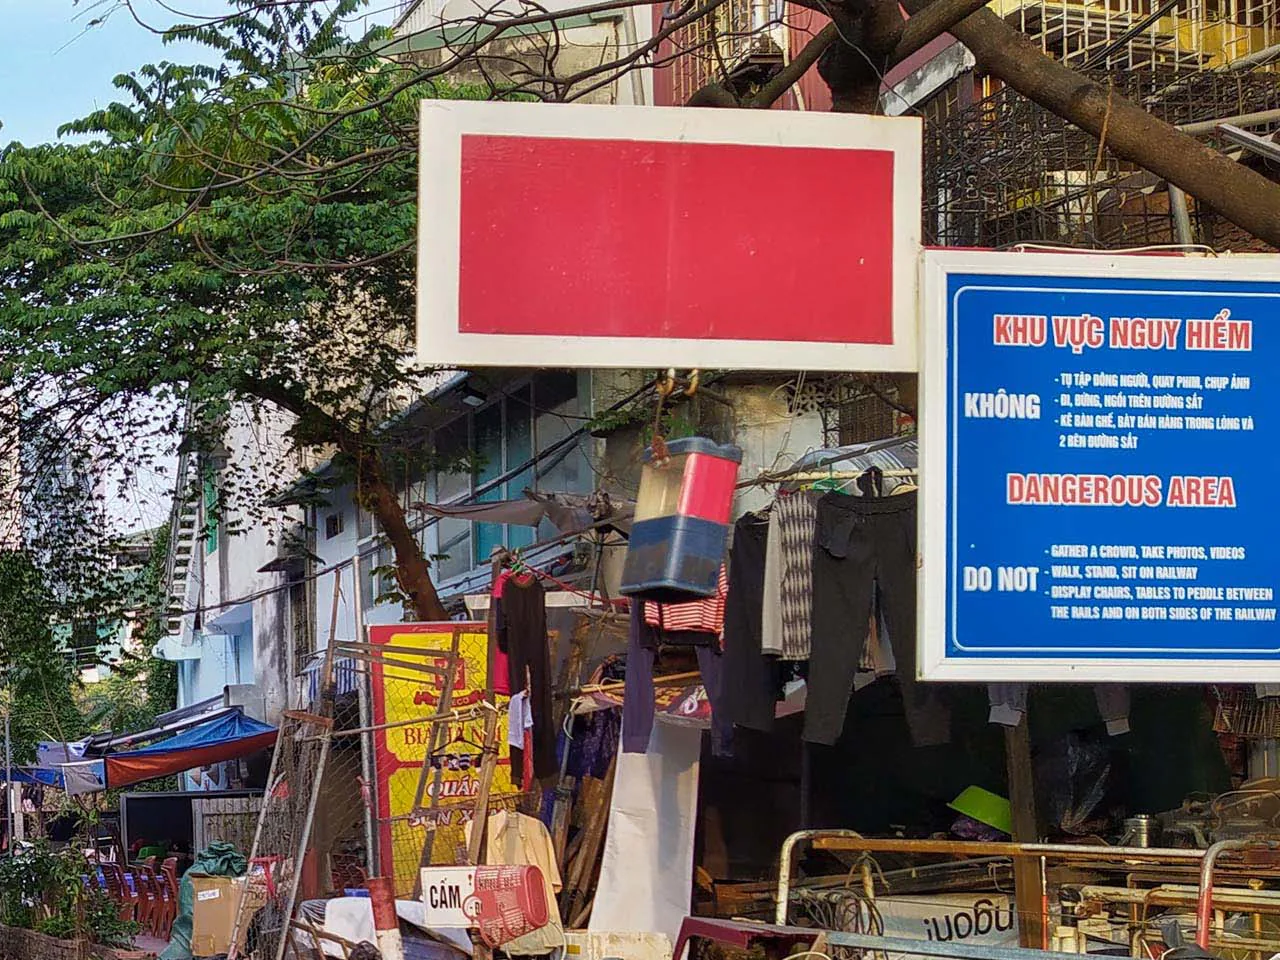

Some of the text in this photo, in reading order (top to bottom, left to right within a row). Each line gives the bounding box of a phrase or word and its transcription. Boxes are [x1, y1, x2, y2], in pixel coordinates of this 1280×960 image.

[993, 309, 1253, 354] KHU VỰC NGUY HIỂM
[1152, 375, 1175, 389] QUAY
[1205, 376, 1229, 392] CHỤP
[964, 388, 1040, 419] KHÔNG
[1185, 417, 1214, 430] TRONG
[1059, 435, 1066, 447] 2
[1006, 473, 1237, 508] DANGEROUS AREA
[1051, 544, 1246, 560] GATHER A CROWD, TAKE PHOTOS, VIDEOS
[963, 566, 1039, 592] DO NOT
[1051, 565, 1198, 580] WALK, STAND, SIT ON RAILWAY
[1051, 586, 1273, 601] DISPLAY CHAIRS, TABLES TO PEDDLE BETWEEN
[1051, 606, 1277, 621] THE RAILS AND ON BOTH SIDES OF THE RAILWAY
[429, 877, 461, 909] CẤM
